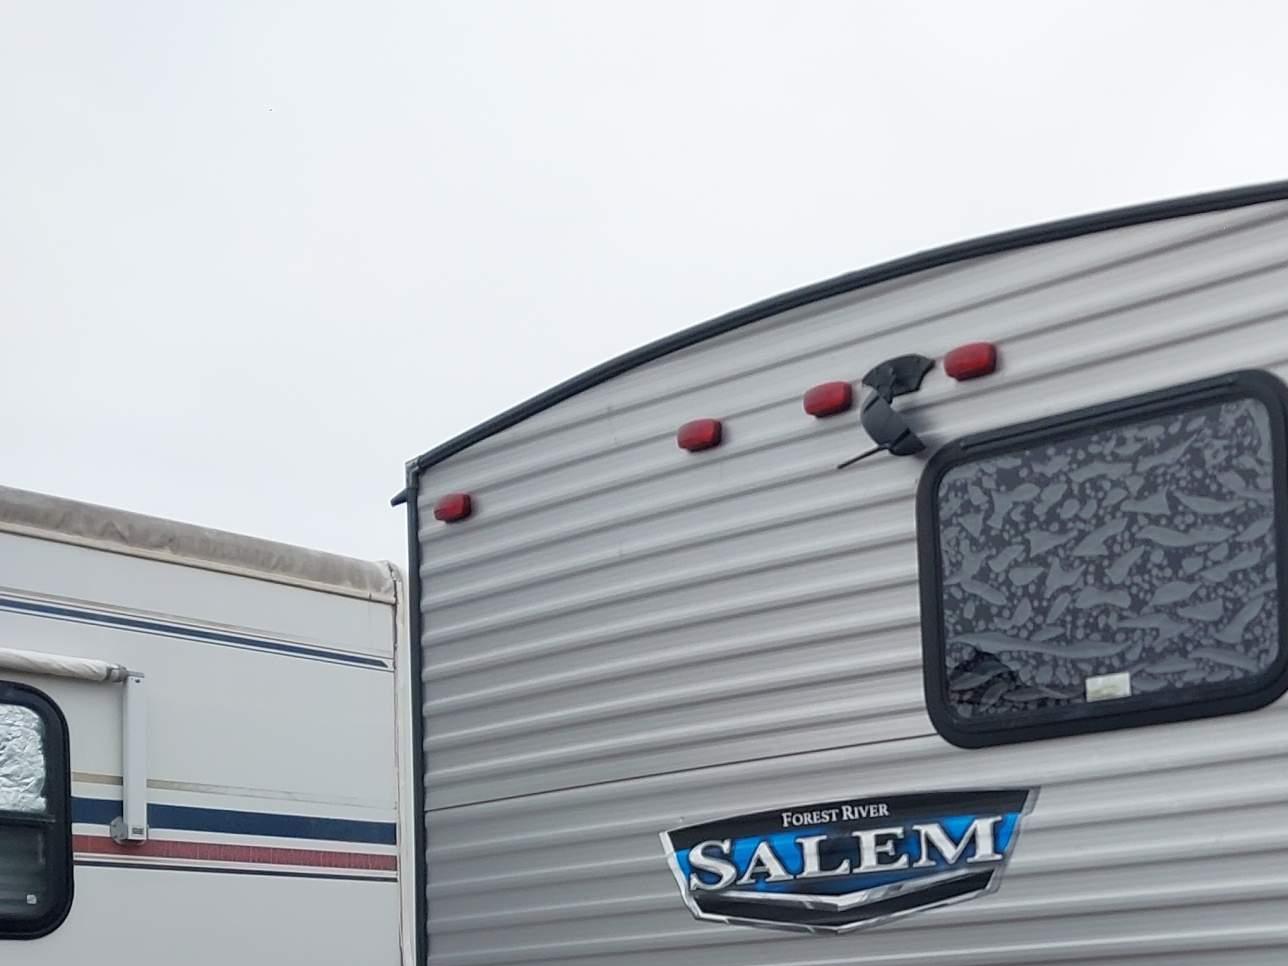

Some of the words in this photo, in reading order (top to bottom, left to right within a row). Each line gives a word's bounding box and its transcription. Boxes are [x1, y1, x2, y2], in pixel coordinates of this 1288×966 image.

[781, 806, 840, 828] FOREST
[841, 803, 890, 821] RIVER
[688, 815, 1004, 892] SALEM
